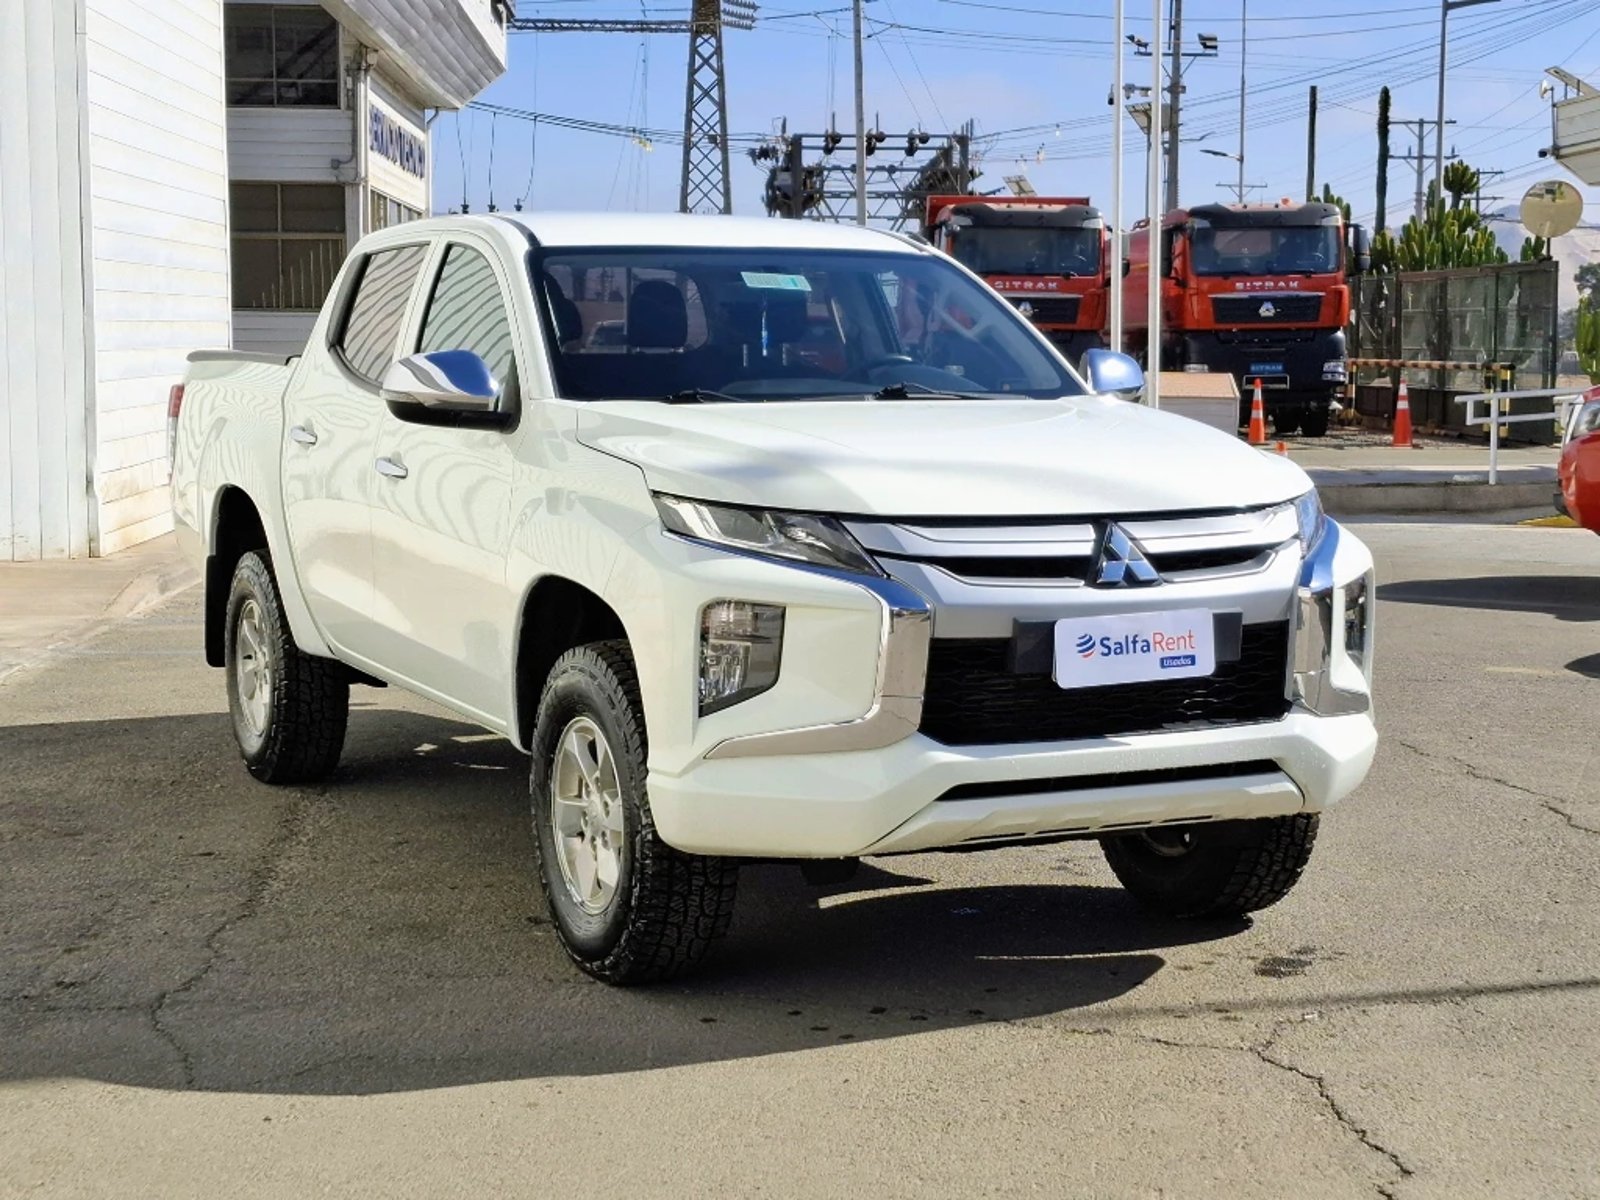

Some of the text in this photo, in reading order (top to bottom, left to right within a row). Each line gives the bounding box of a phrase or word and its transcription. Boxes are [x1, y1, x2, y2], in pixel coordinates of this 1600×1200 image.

[994, 280, 1058, 290] SITRAK
[1235, 280, 1299, 290] SITRAK
[1099, 629, 1196, 657] SalfaRent
